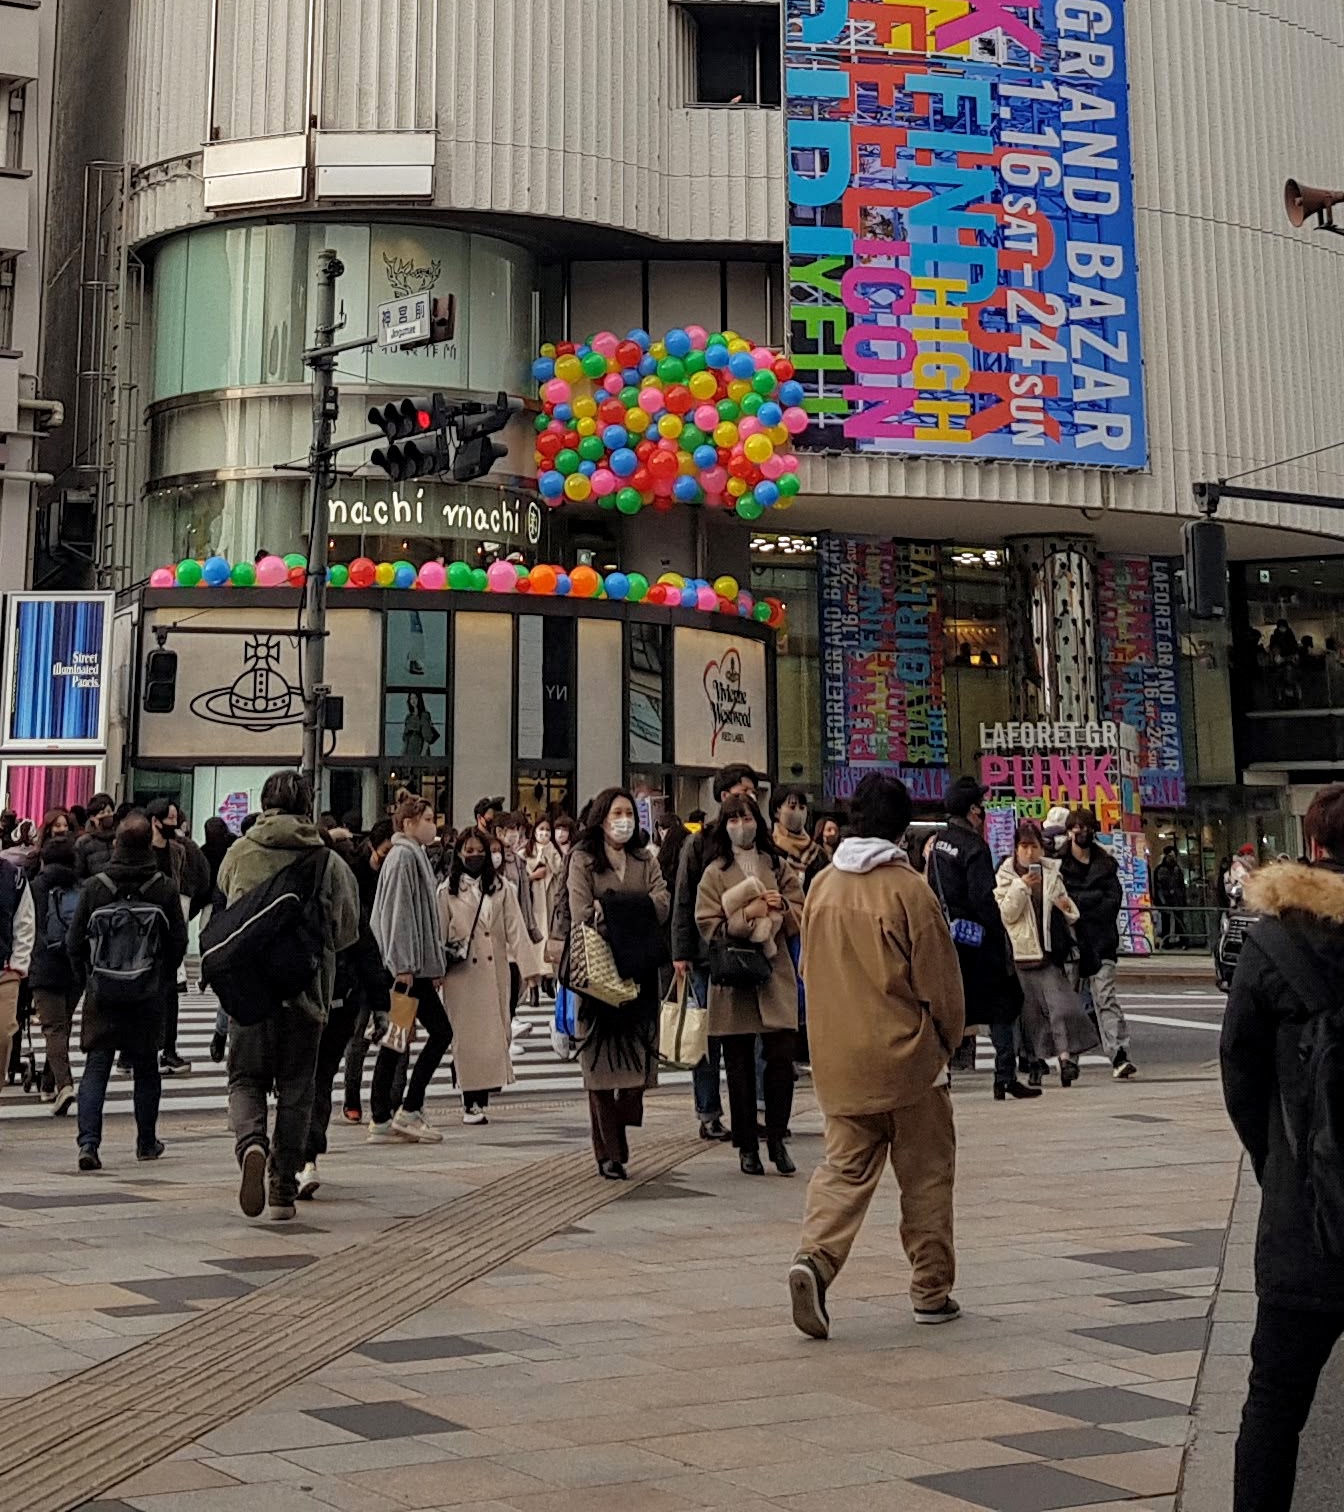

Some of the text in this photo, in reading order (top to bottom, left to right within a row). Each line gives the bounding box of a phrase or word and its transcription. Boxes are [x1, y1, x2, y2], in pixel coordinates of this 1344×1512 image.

[905, 73, 999, 304] FIND
[840, 239, 918, 439] ICON
[911, 276, 972, 443] HIGH
[1065, 240, 1132, 451] BAZAR
[442, 499, 521, 534] machi
[72, 651, 98, 664] Street
[979, 720, 1080, 750] LAFORET
[981, 753, 1117, 801] PUNK
